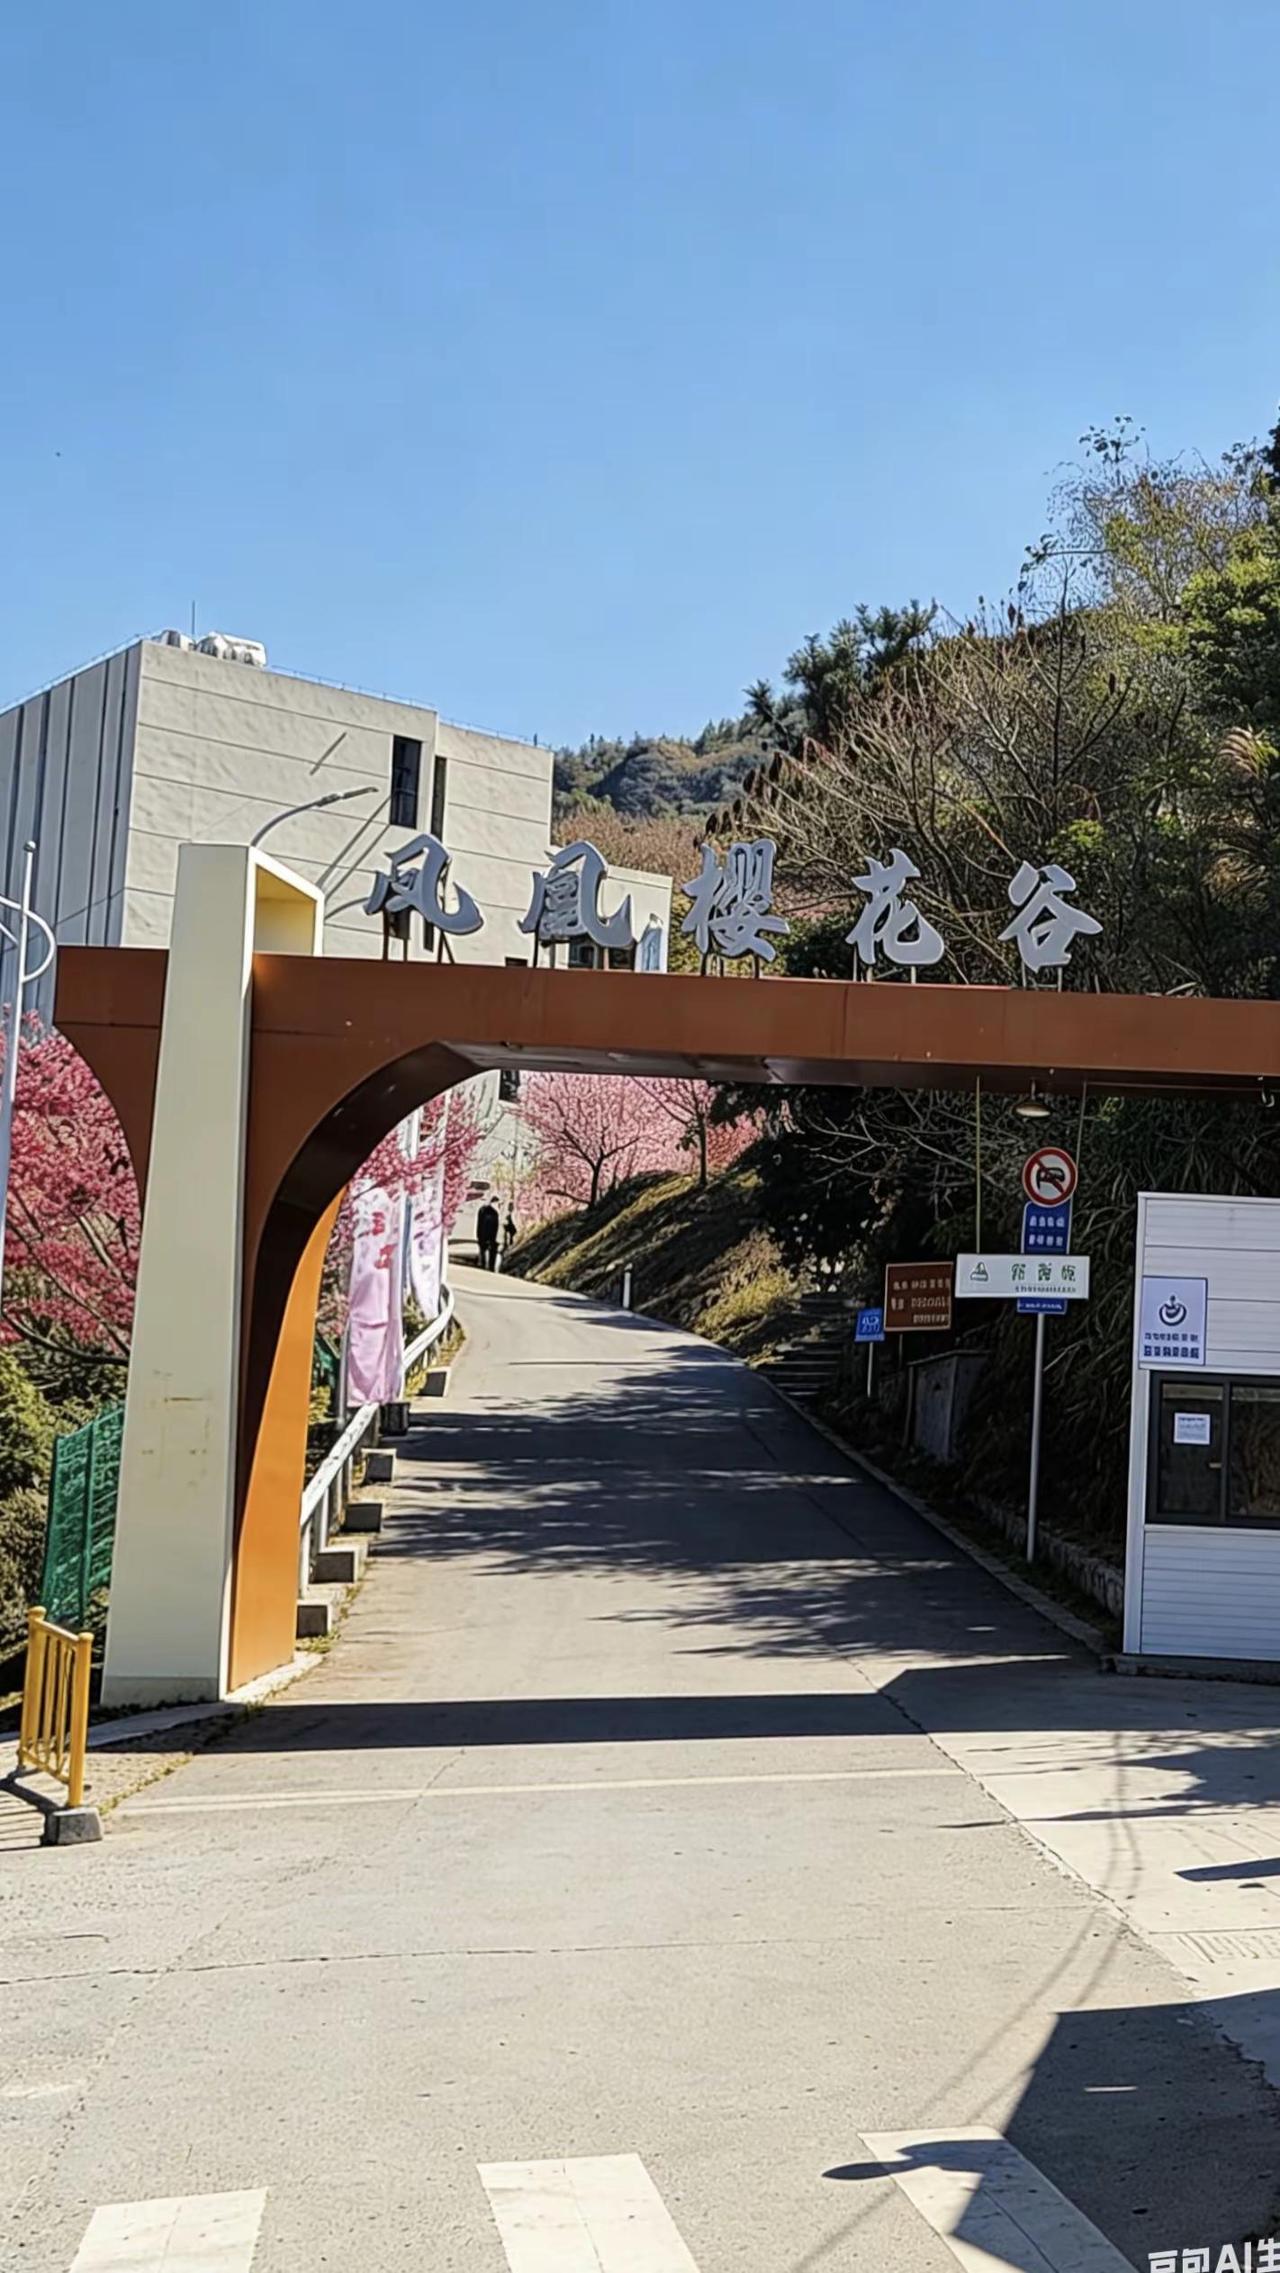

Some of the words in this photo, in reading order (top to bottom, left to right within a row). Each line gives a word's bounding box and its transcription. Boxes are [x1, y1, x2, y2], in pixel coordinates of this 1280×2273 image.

[362, 833, 1104, 973] 凤凰樱花谷
